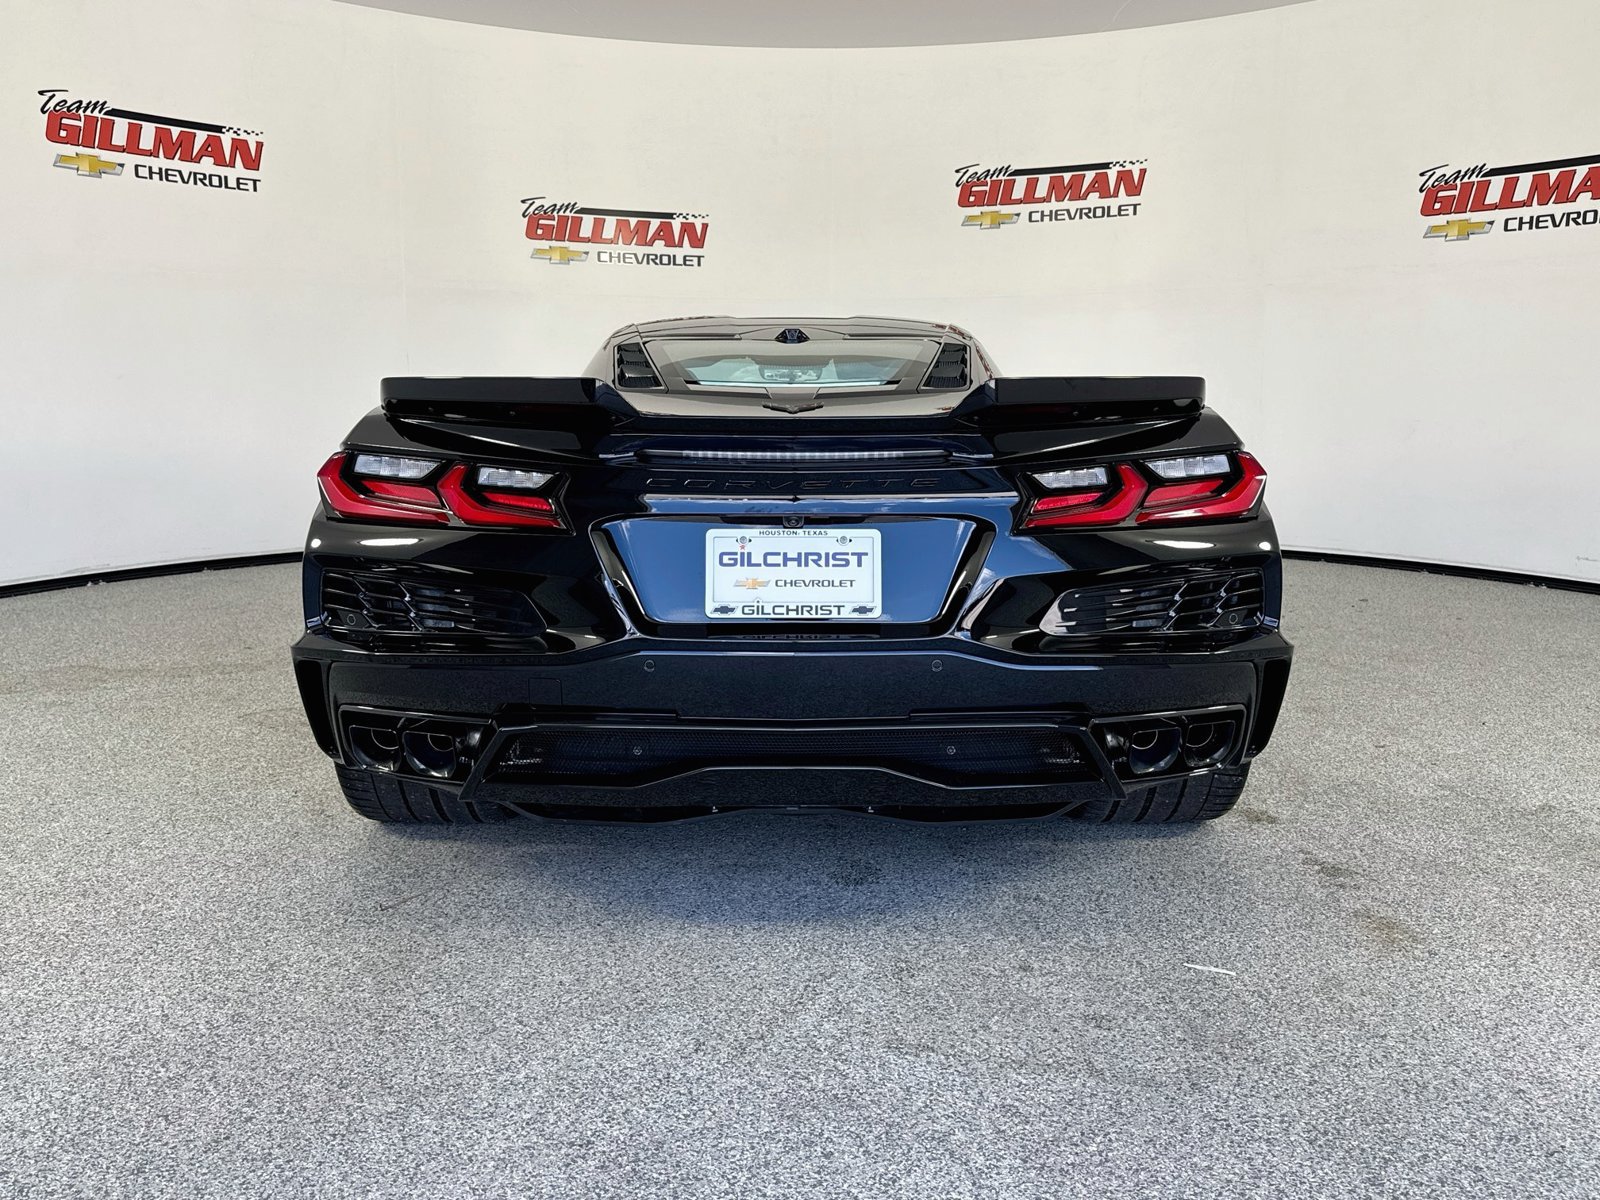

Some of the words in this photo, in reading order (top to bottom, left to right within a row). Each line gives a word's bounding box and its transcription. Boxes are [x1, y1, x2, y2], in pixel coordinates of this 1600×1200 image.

[38, 89, 109, 115] Team
[45, 111, 264, 171] GILLMAN
[134, 164, 261, 192] CHEVROLET
[955, 164, 1013, 188] Team
[957, 168, 1147, 207] GILLMAN
[1419, 163, 1488, 193] Team
[520, 196, 578, 218] Team
[1028, 203, 1141, 223] CHEVROLET
[525, 214, 709, 249] GILLMAN
[1503, 209, 1600, 232] CHEVRO
[597, 251, 705, 267] CHEVROLET
[646, 478, 940, 489] CORVETTE
[718, 551, 869, 568] GILCHRIST
[774, 579, 856, 588] CHEVROLET
[741, 604, 846, 616] GILCHRIST
